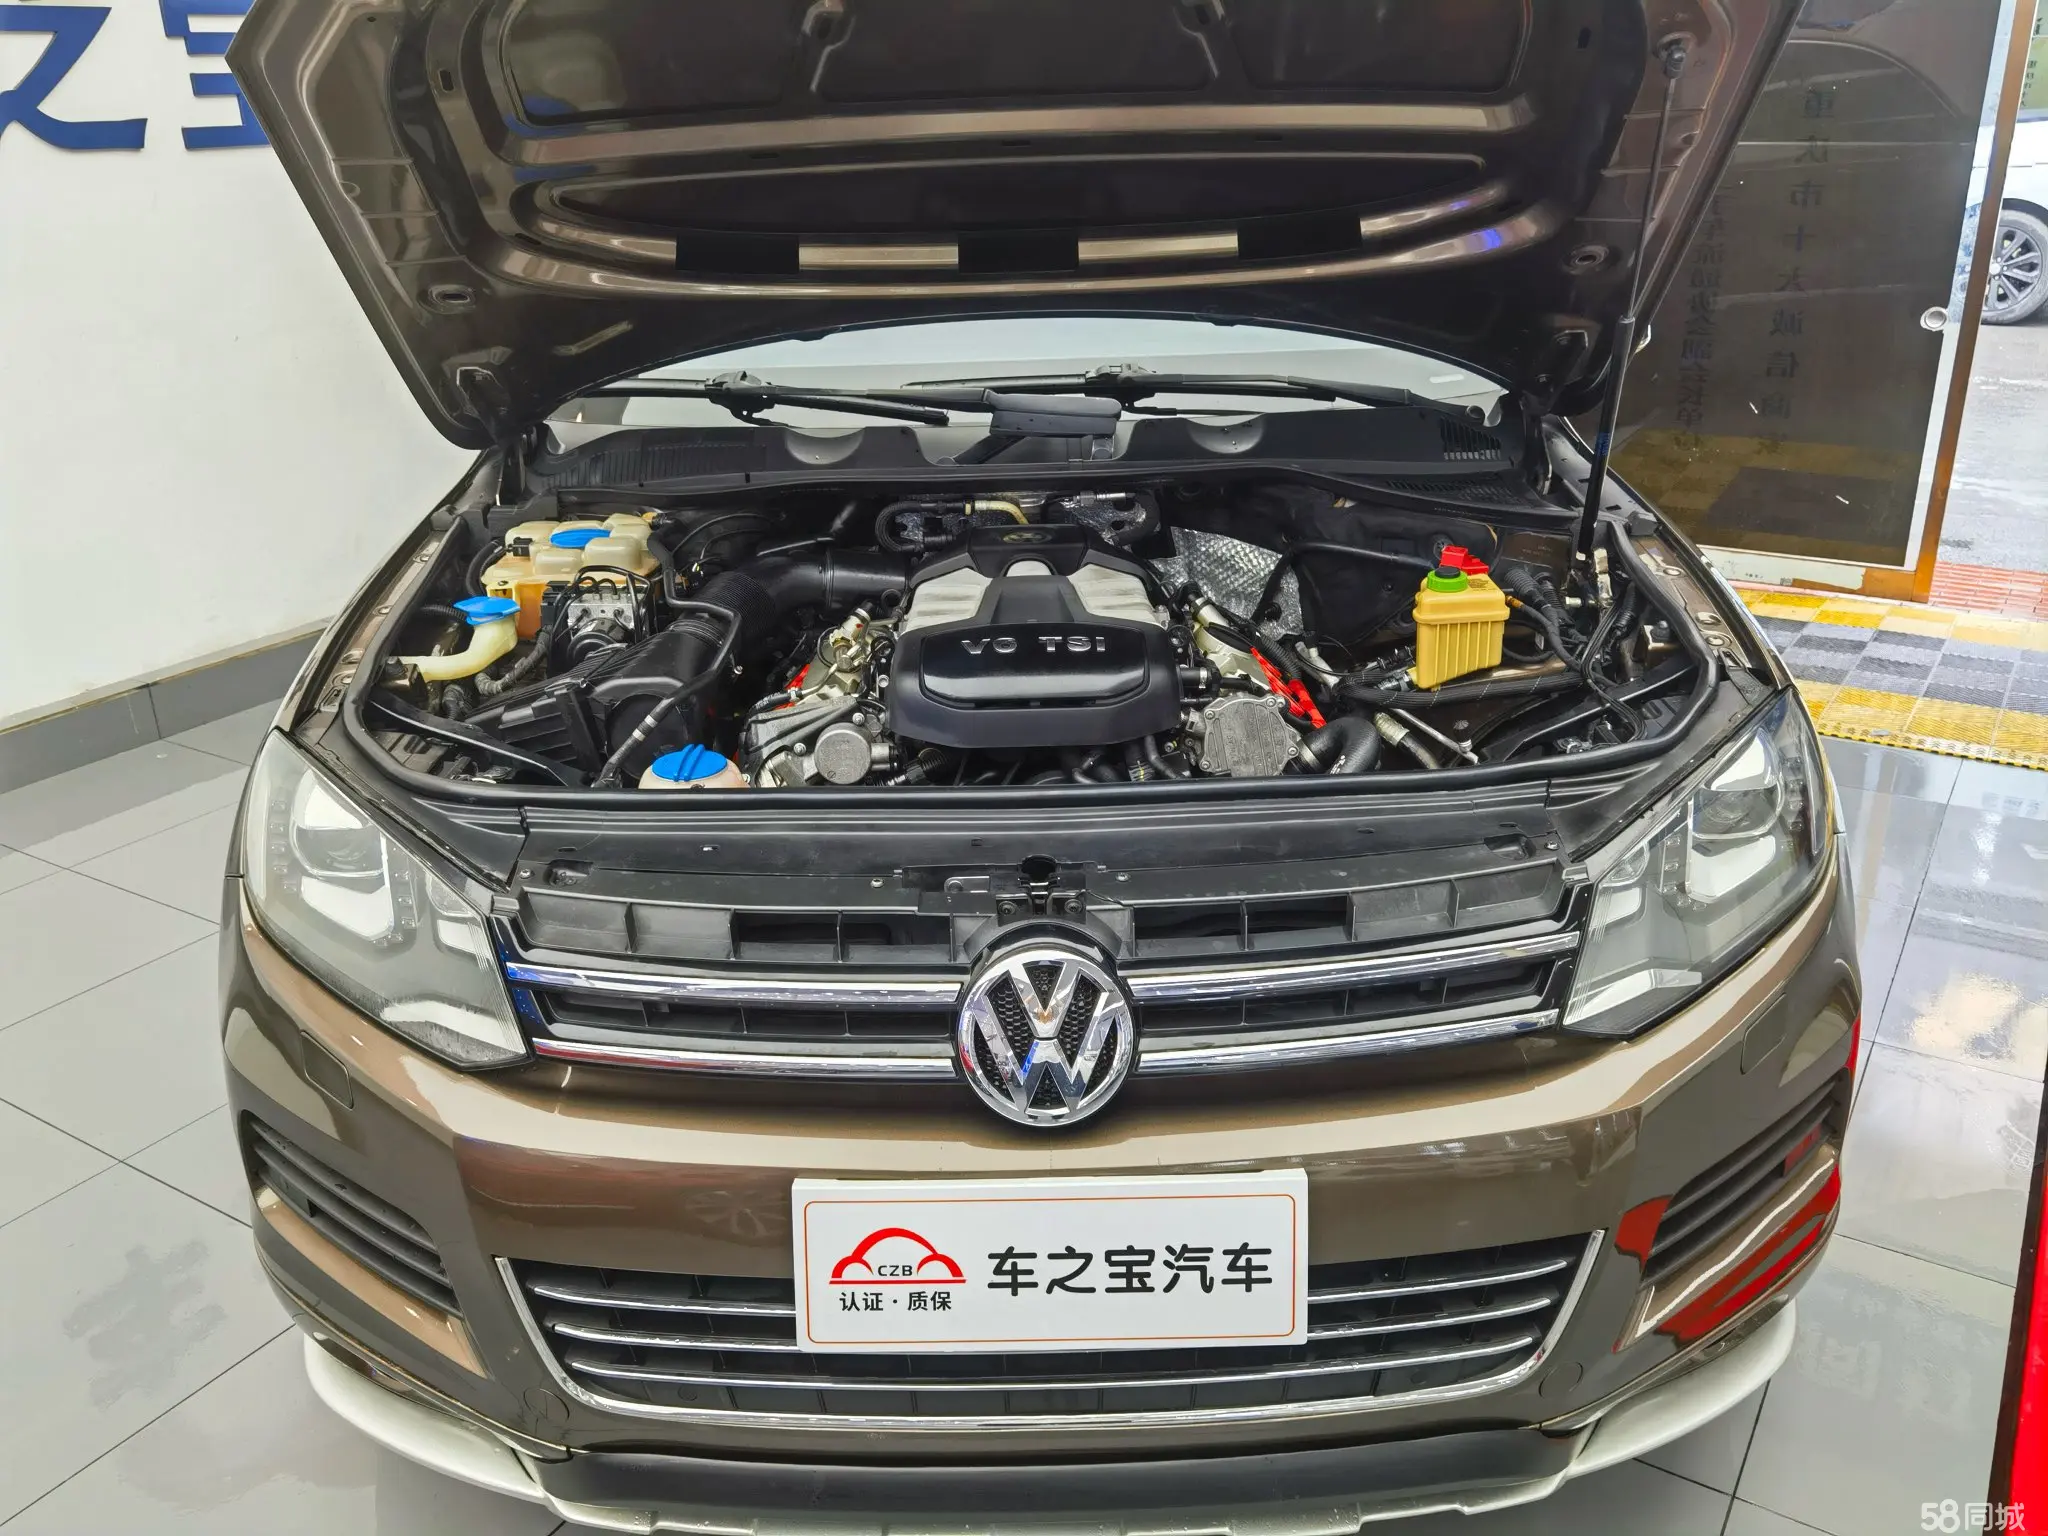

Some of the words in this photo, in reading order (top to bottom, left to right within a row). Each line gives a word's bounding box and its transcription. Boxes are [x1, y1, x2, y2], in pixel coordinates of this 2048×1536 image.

[1038, 636, 1106, 652] TSI
[959, 950, 1133, 1126] VW
[877, 1264, 913, 1278] CZB
[987, 1242, 1274, 1297] 车之宝汽车
